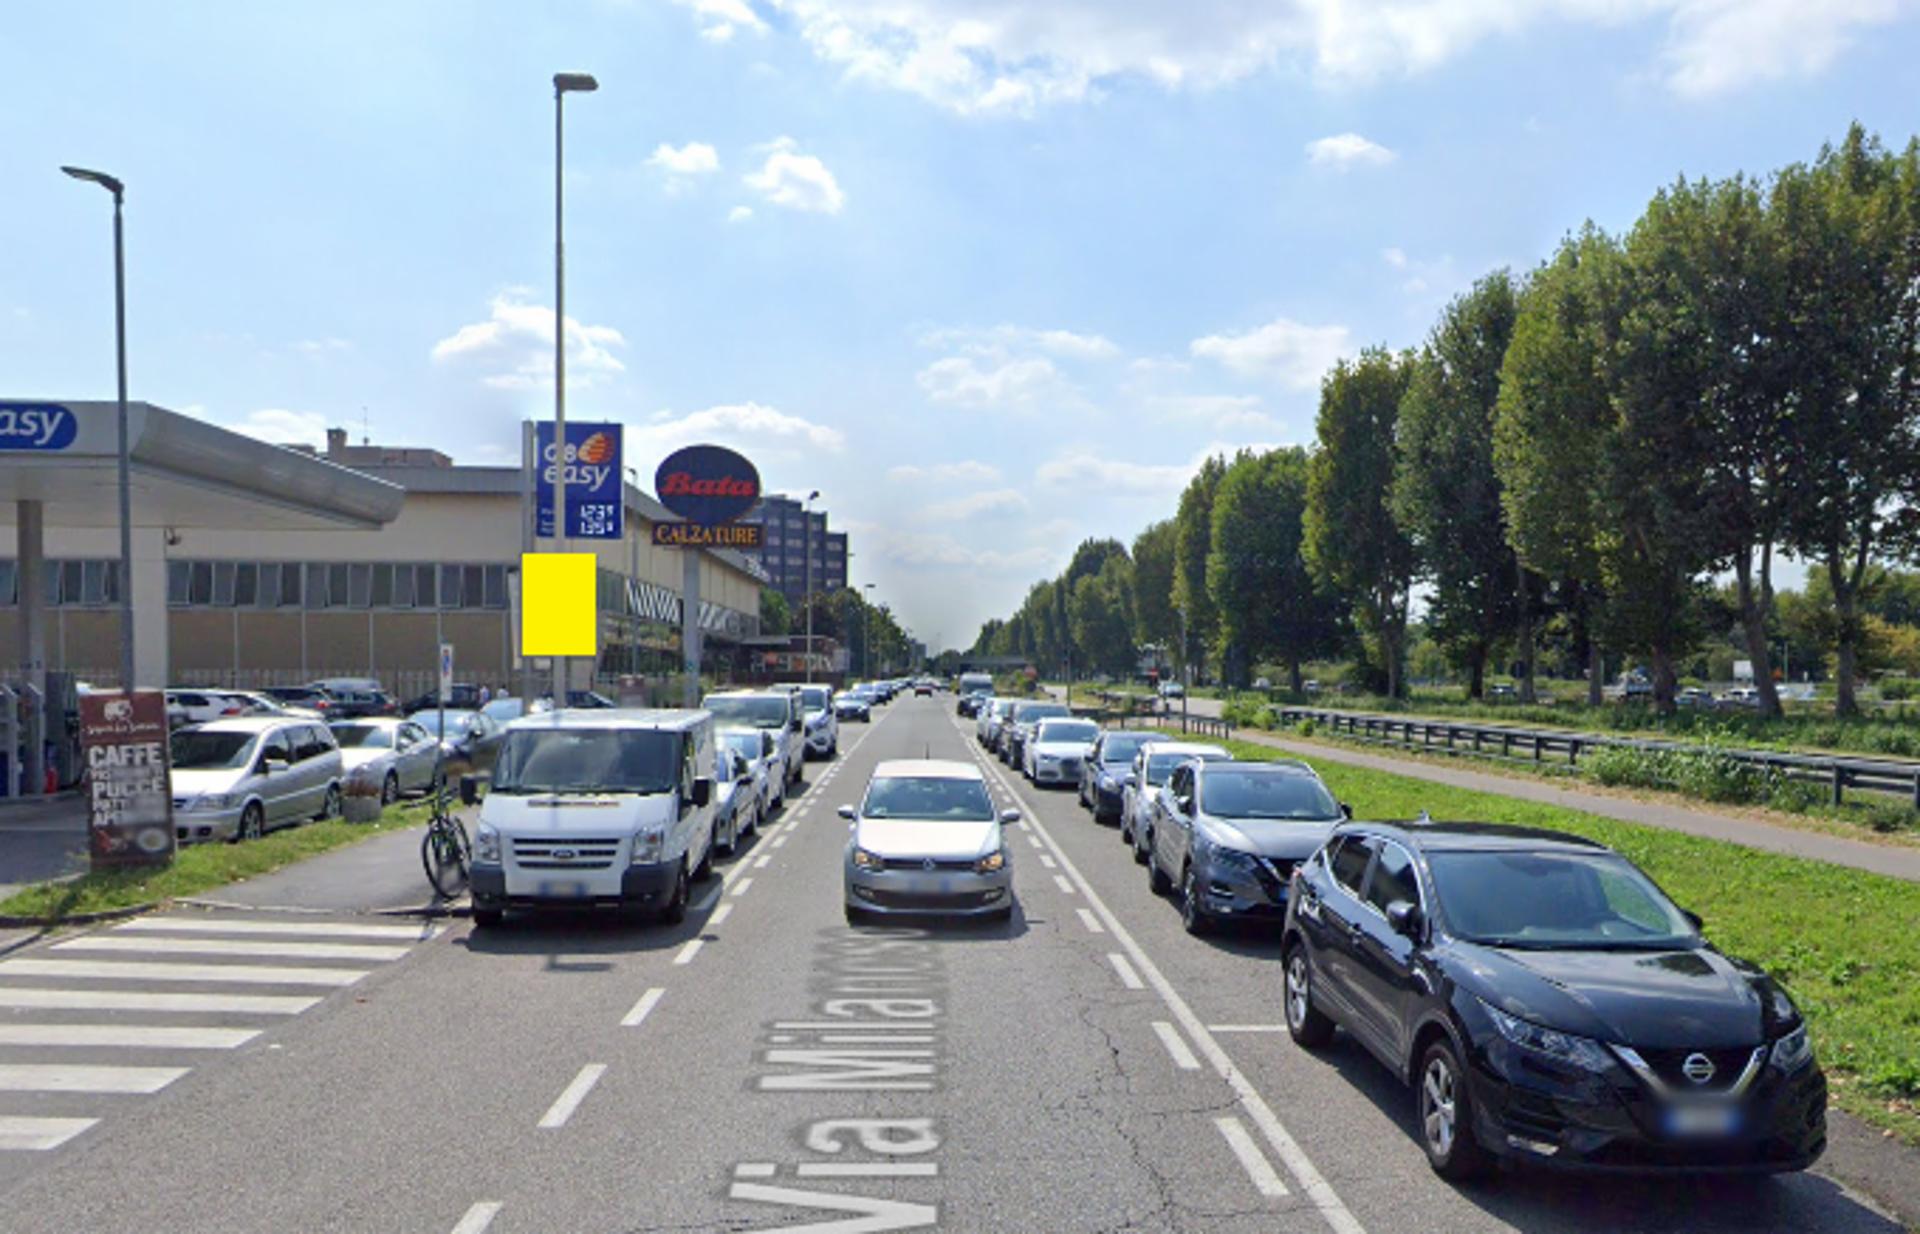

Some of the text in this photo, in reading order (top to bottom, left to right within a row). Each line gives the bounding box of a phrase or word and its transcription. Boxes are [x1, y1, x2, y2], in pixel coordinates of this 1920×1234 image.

[543, 465, 611, 492] easy
[660, 471, 754, 497] Bata
[656, 524, 758, 545] CALZATURE
